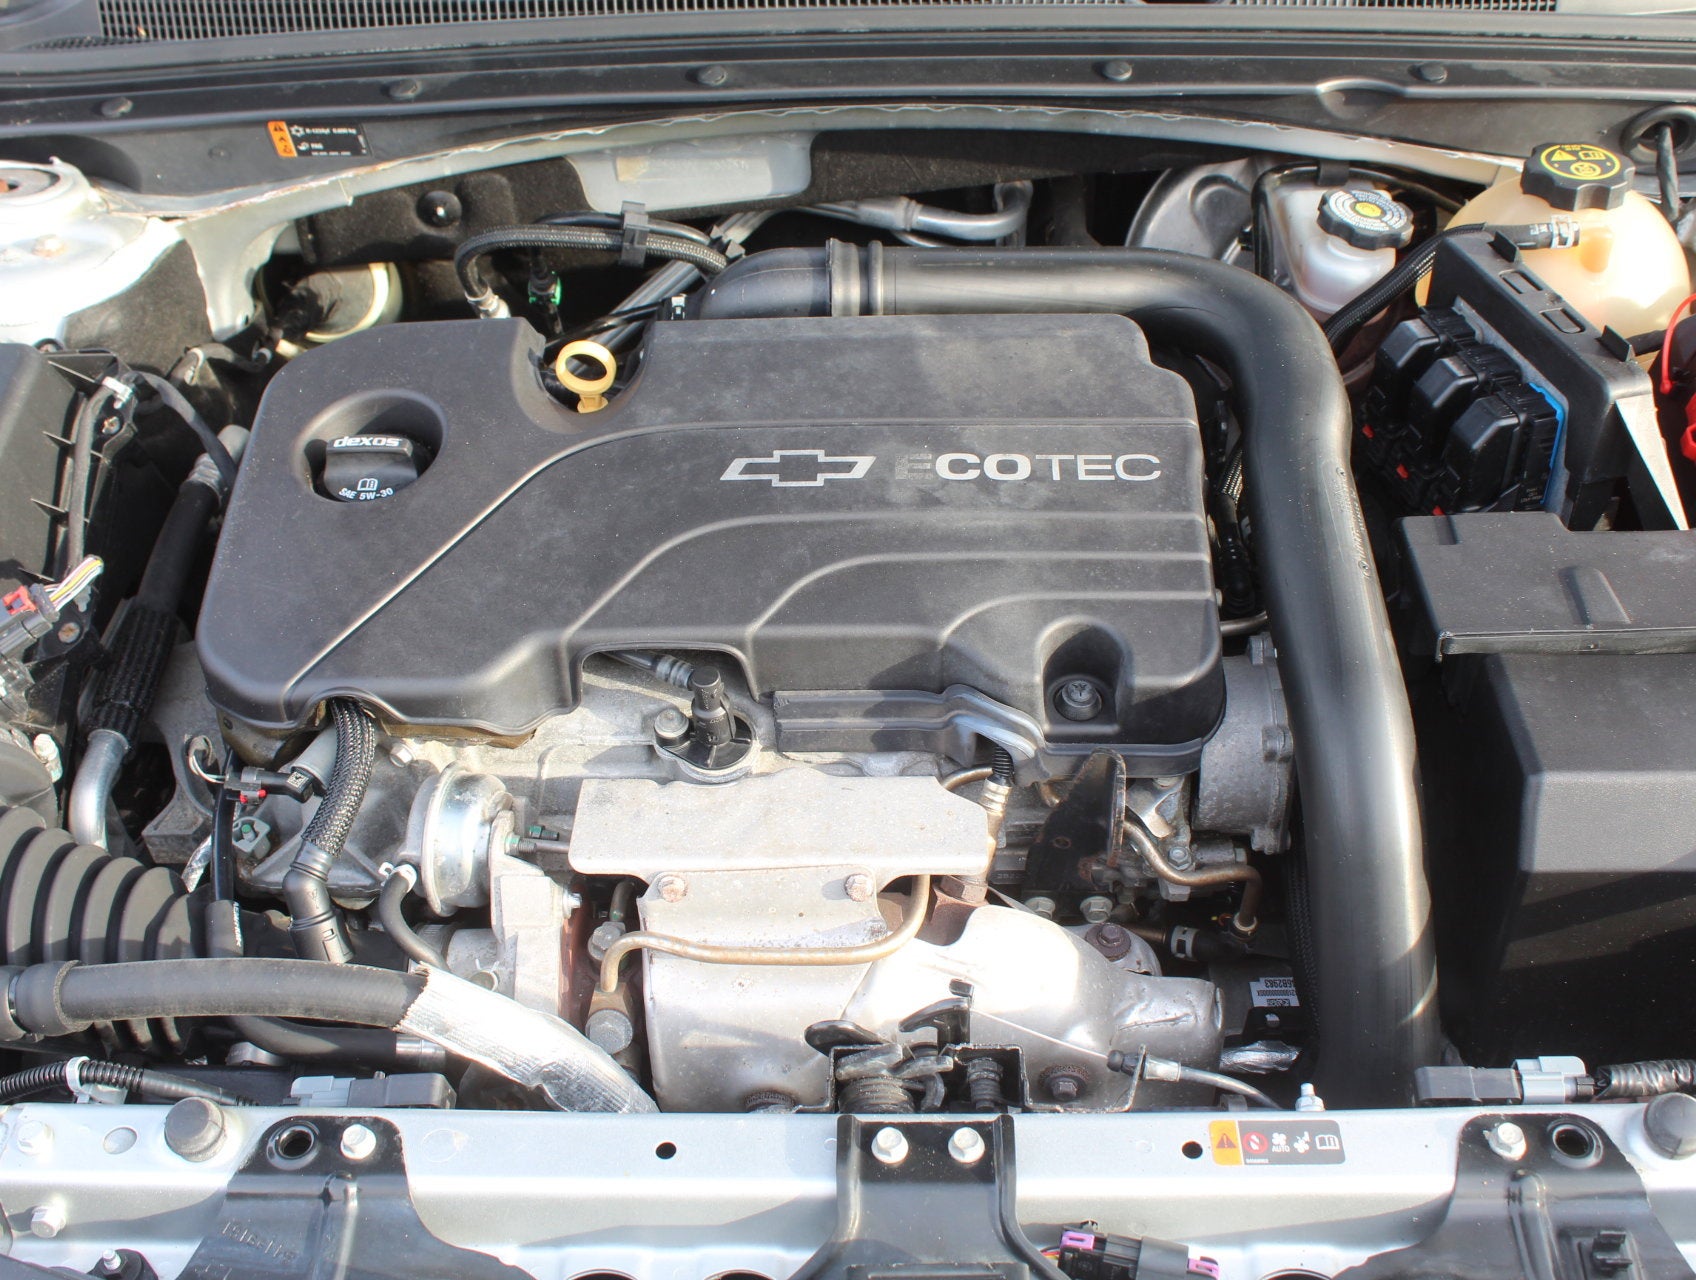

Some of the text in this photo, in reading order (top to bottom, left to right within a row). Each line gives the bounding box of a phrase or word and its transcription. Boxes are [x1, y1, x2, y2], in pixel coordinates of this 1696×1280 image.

[333, 435, 400, 448] dexos
[894, 452, 1162, 482] ECOTEC
[339, 487, 394, 500] SAE 5W-30
[1271, 1145, 1290, 1153] AUTO
